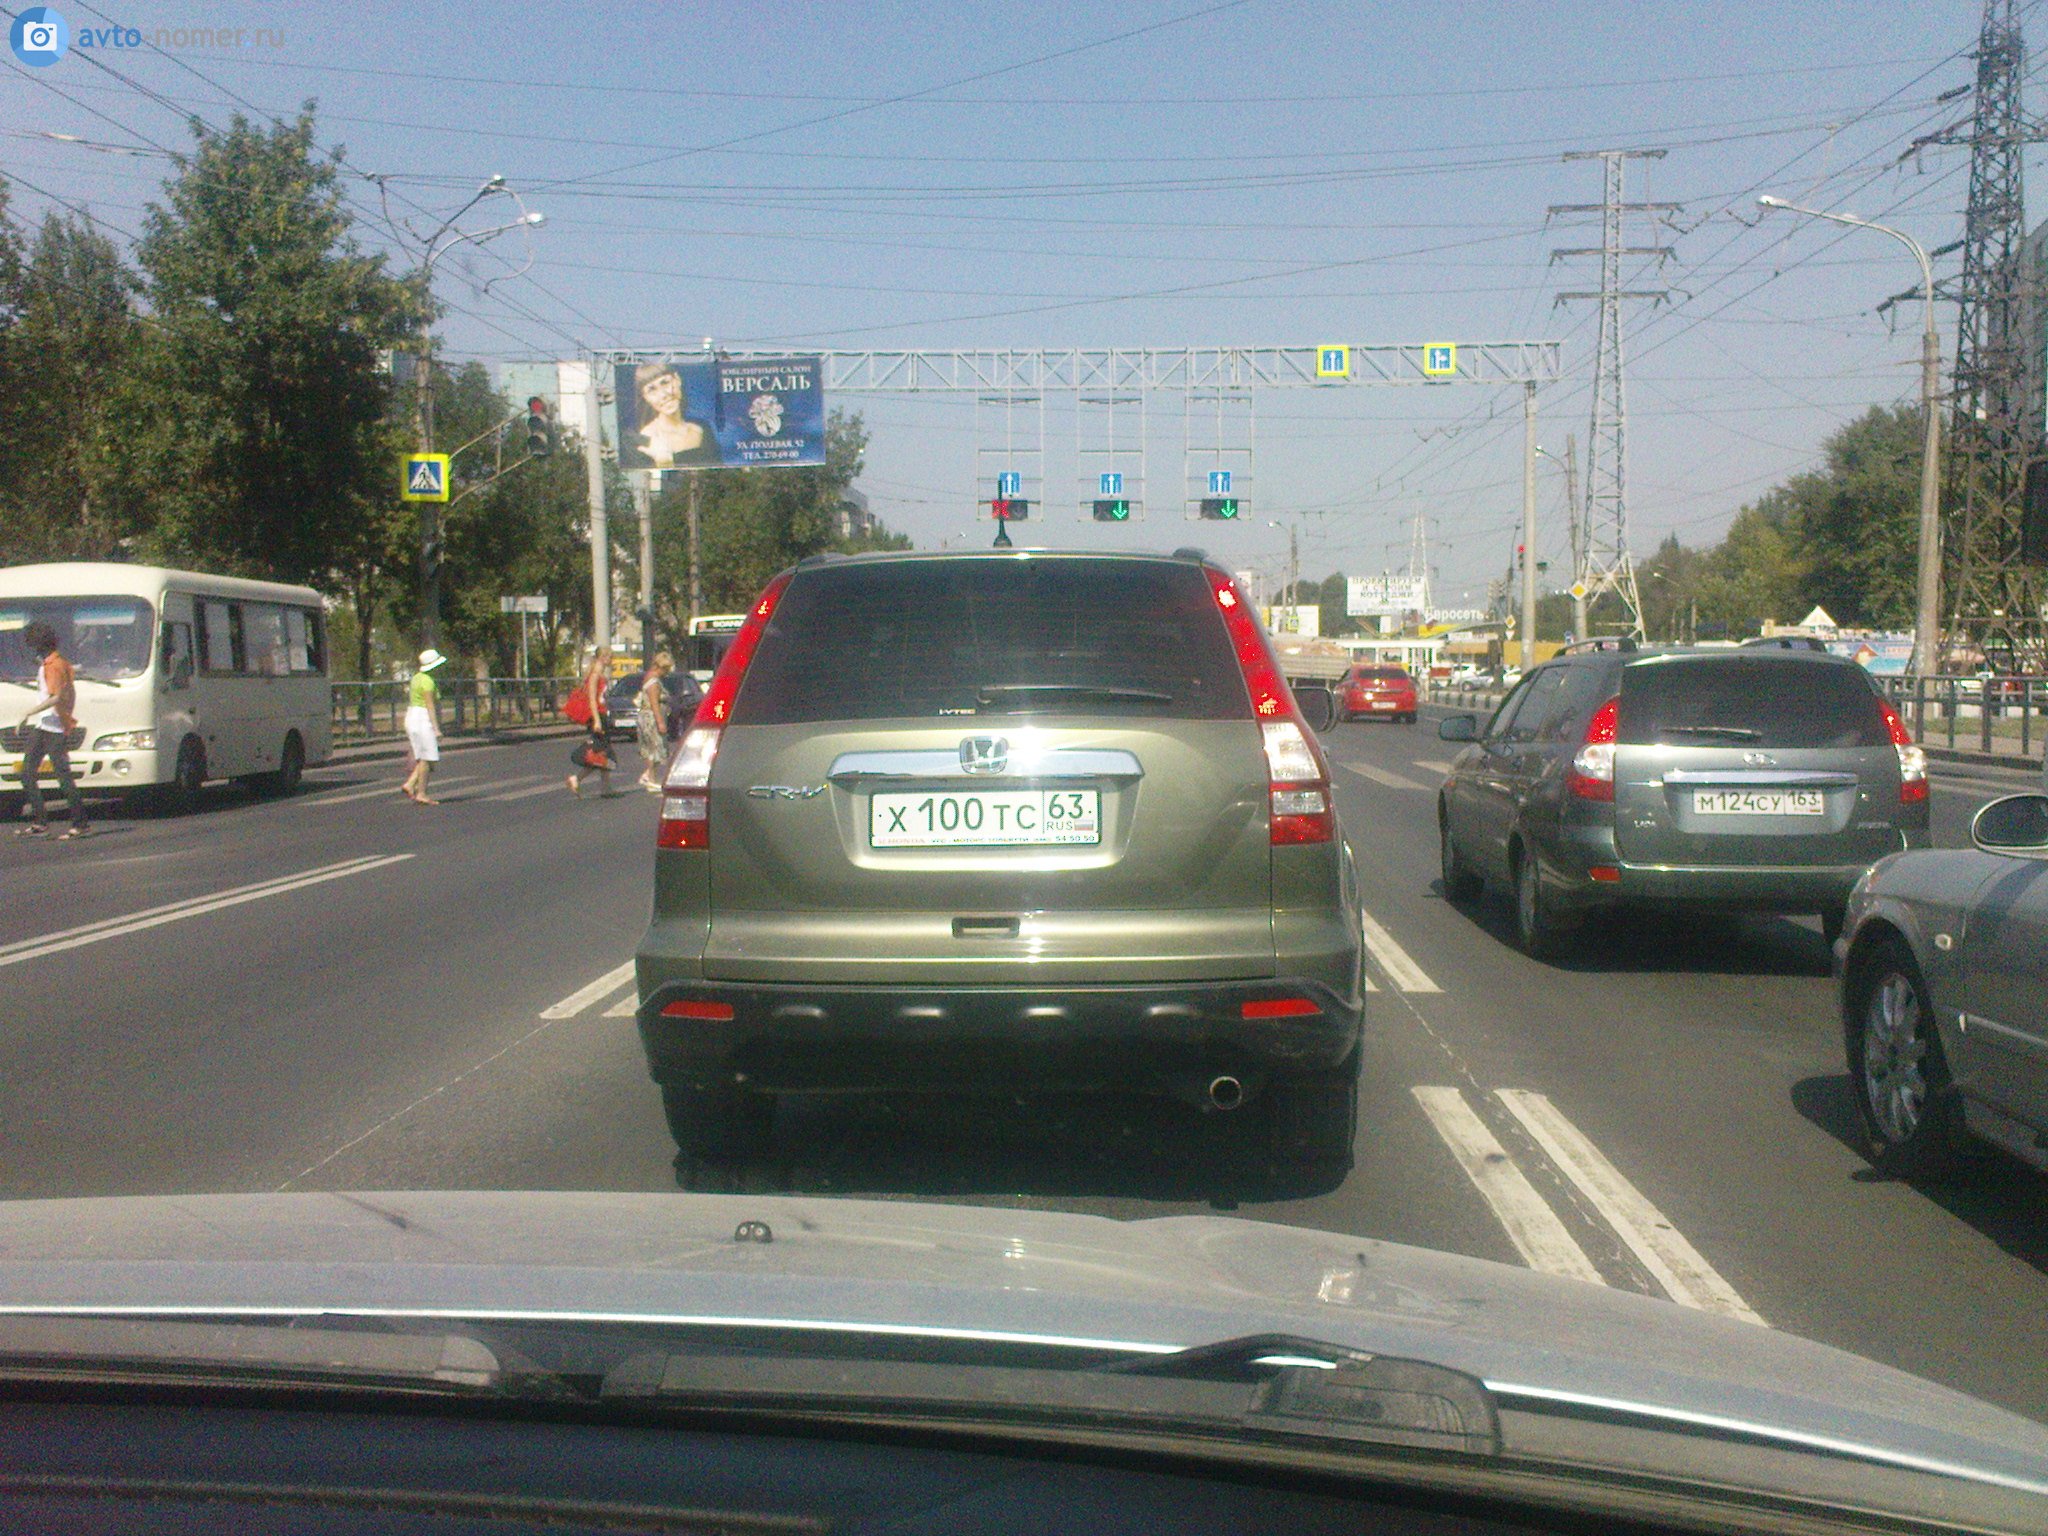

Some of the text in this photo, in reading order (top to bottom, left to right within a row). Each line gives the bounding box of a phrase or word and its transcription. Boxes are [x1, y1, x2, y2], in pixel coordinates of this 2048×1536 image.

[722, 375, 811, 393] ВЕРСАЛЬ
[1048, 793, 1084, 819] 63
[1788, 791, 1817, 806] 163
[1046, 820, 1073, 831] RUS
